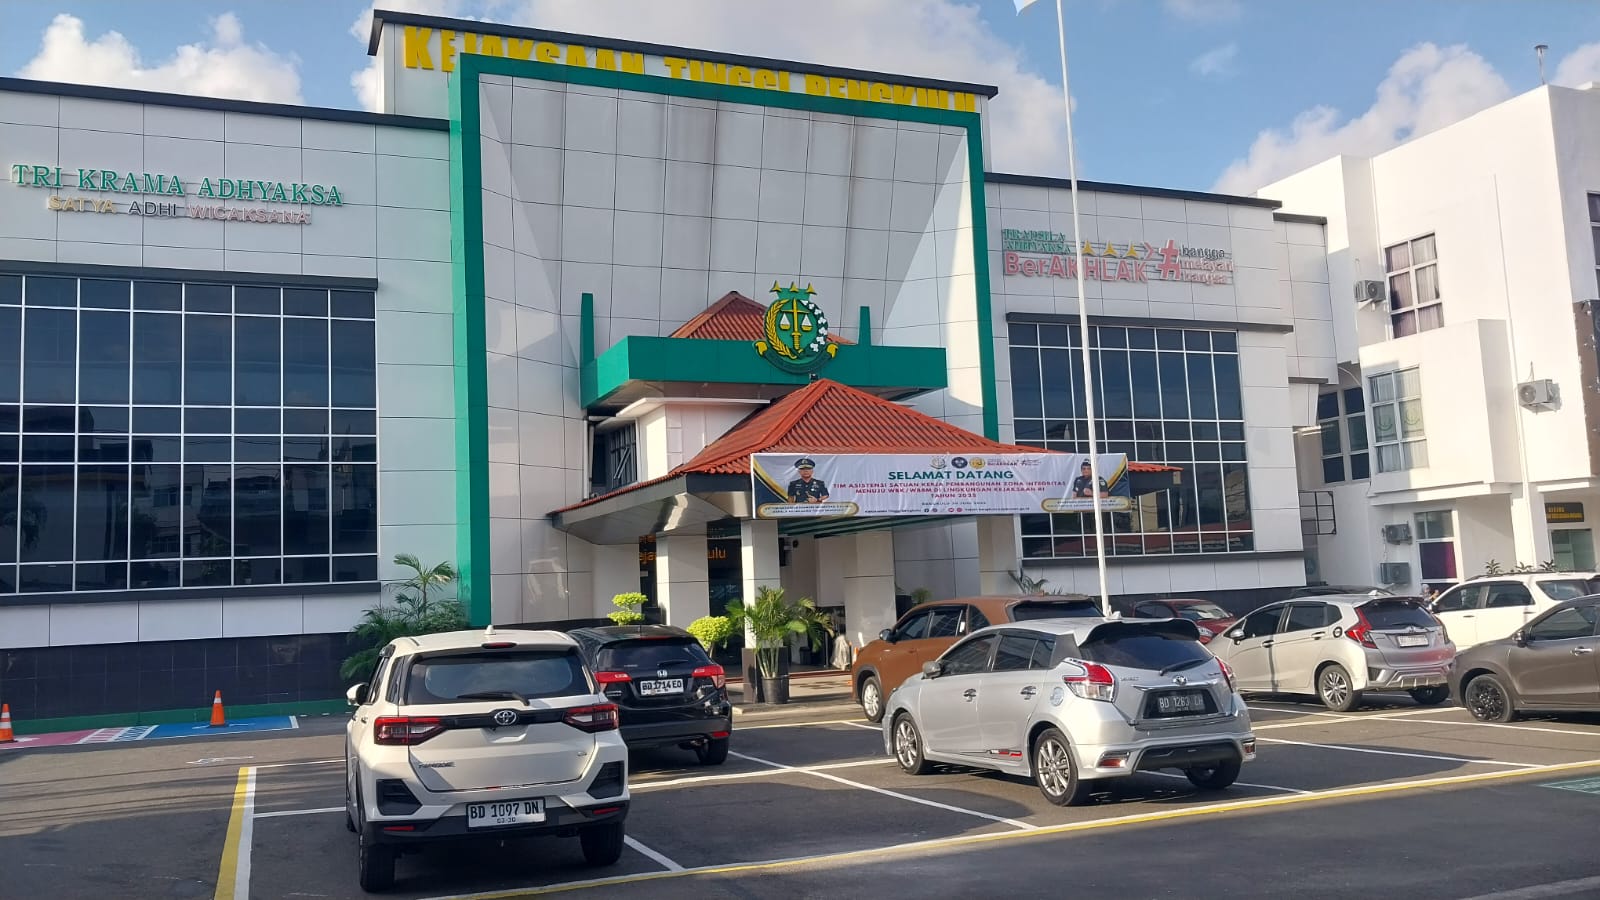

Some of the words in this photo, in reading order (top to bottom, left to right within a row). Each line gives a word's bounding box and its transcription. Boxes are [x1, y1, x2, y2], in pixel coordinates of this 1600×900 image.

[12, 163, 62, 189] TRI
[77, 167, 185, 196] KRAMA
[197, 176, 344, 206] ADHYAKSA
[47, 195, 117, 214] SATYA
[127, 200, 177, 217] ADHI
[187, 203, 312, 225] WICAKSANA
[1181, 245, 1225, 260] bangga
[1005, 251, 1149, 282] BerAKHLAK
[888, 472, 951, 480] SELAMAT
[956, 470, 1014, 479] DATANG
[642, 681, 652, 691] BD
[653, 679, 672, 690] 1714
[1160, 696, 1170, 708] BD
[1173, 695, 1190, 707] 1263
[470, 806, 486, 819] BD
[491, 803, 520, 817] 1097
[524, 801, 539, 815] DN
